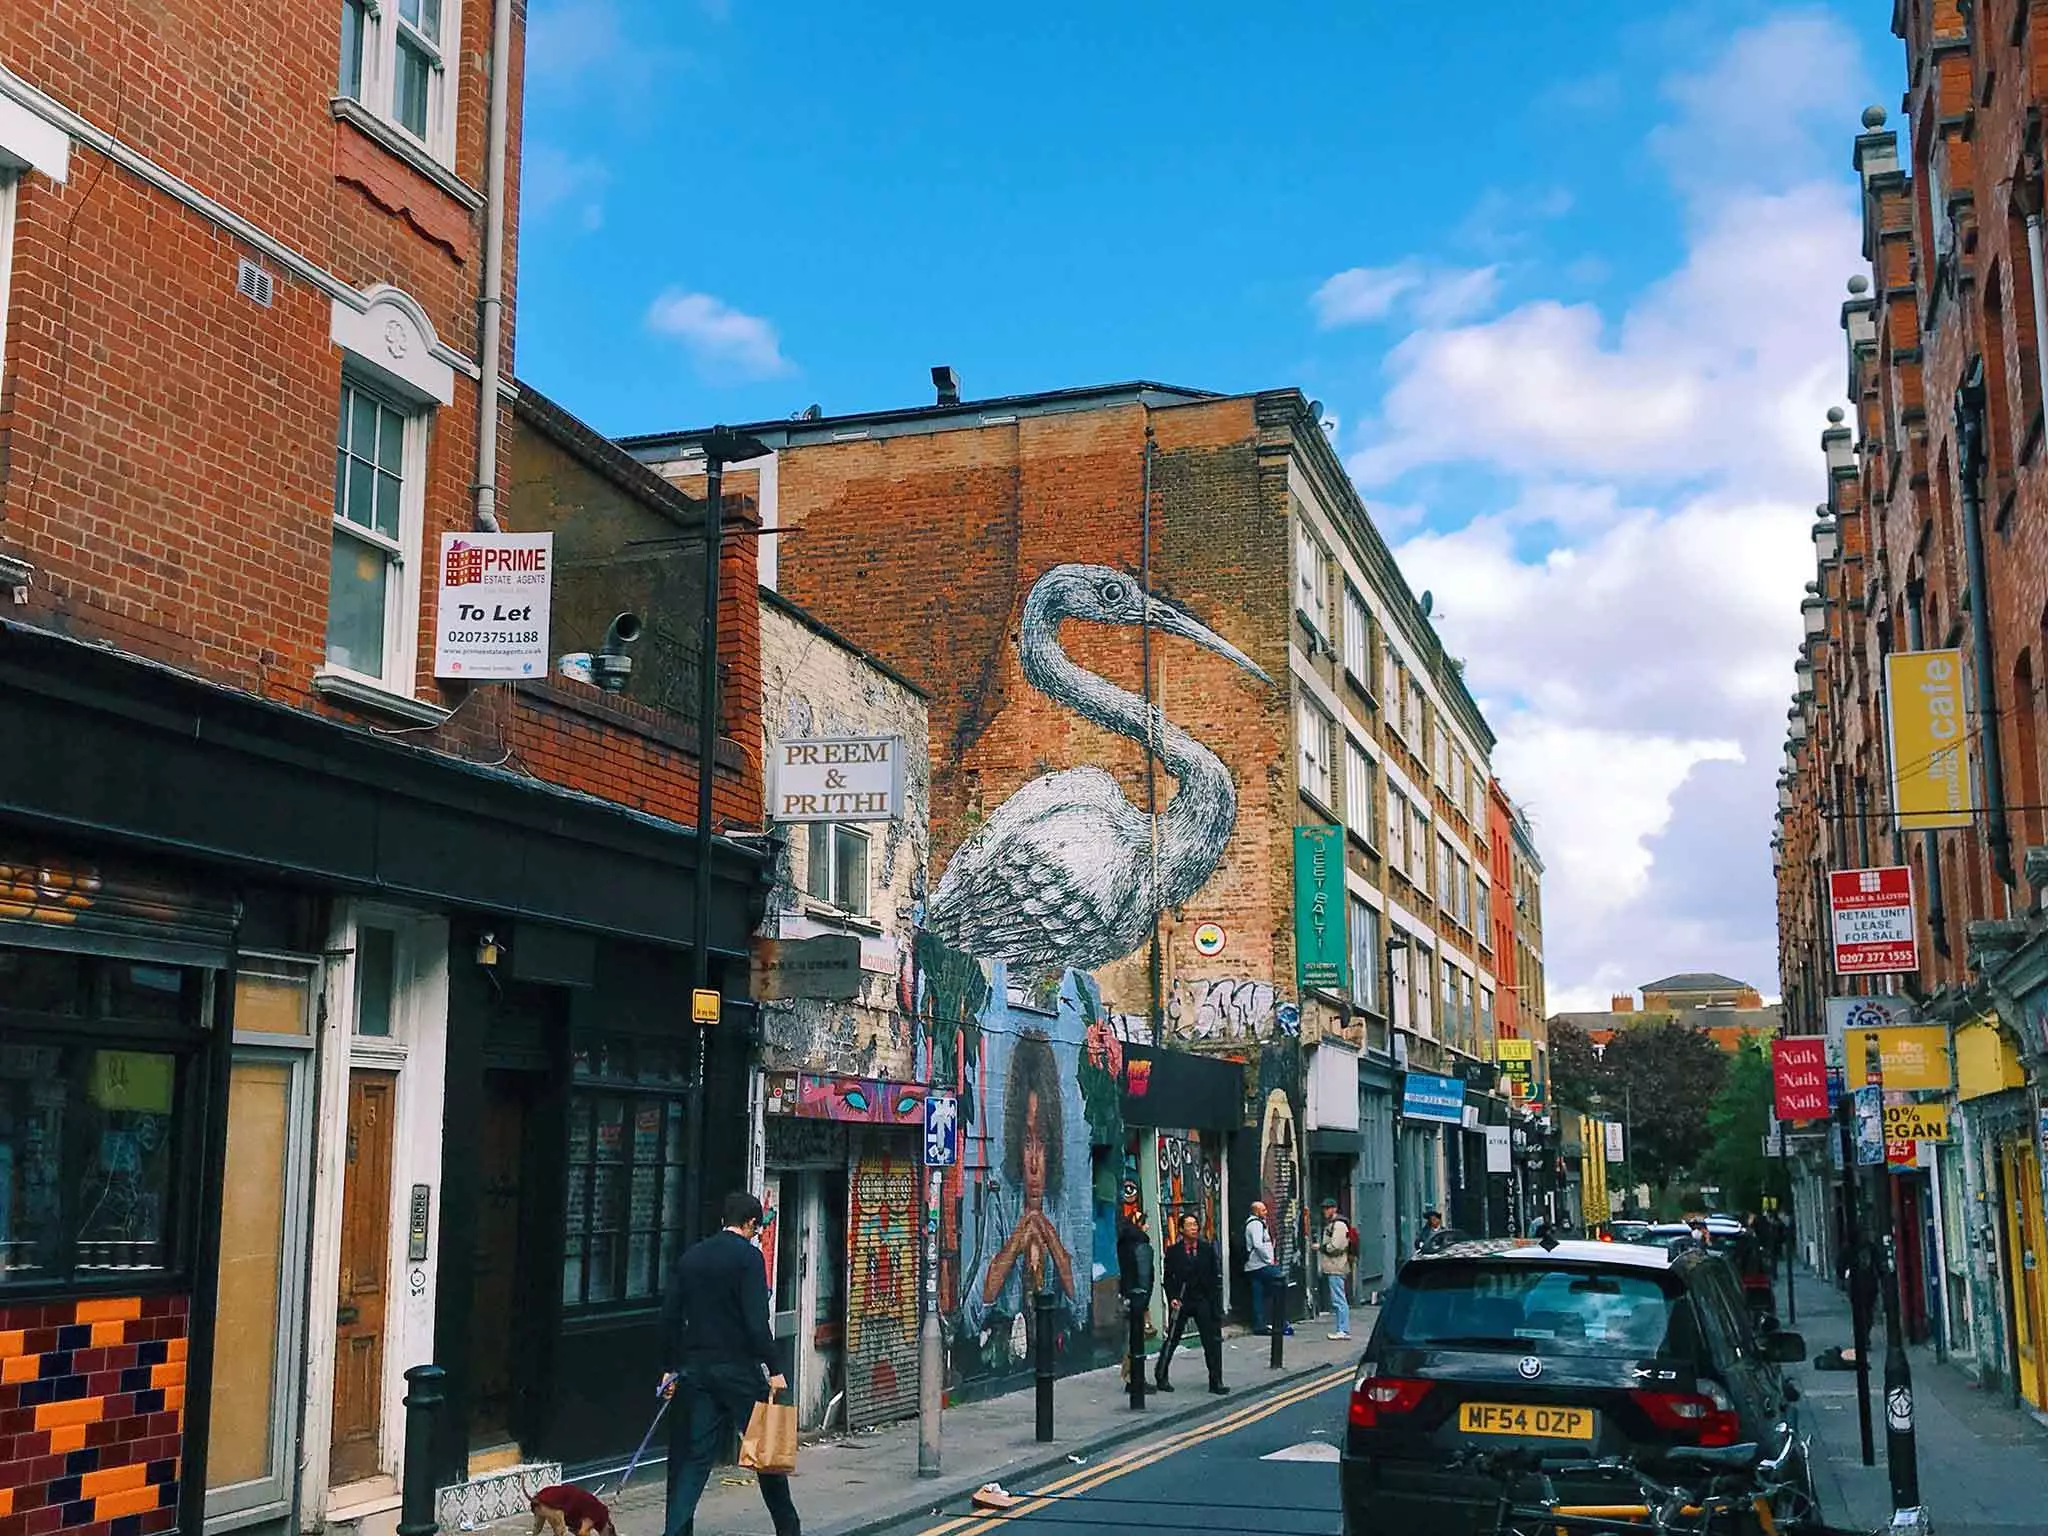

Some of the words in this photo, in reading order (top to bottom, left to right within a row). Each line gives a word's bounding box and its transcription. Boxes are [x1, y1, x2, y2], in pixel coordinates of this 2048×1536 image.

[484, 549, 546, 571] PRIME
[484, 575, 512, 585] ESTATE
[516, 574, 546, 584] AGENTS
[458, 605, 485, 621] To
[493, 604, 531, 621] Let
[448, 631, 539, 643] 02073751188
[1919, 658, 1957, 740] cafe
[784, 742, 889, 765] PREEM
[825, 768, 847, 789] &
[782, 792, 888, 814] PRITHI
[1839, 911, 1878, 921] RETAIL
[1881, 908, 1906, 919] UNIT
[1854, 920, 1893, 931] LEASE
[1845, 932, 1869, 942] FOR
[1873, 930, 1903, 940] SALE
[1839, 953, 1864, 964] 0207
[1888, 950, 1913, 961] 1555
[1778, 1050, 1818, 1065] Nails
[1780, 1072, 1820, 1088] Nails
[1782, 1093, 1822, 1110] Nails
[1884, 1122, 1942, 1138] EGAN
[1507, 1178, 1516, 1238] VINTAG
[1468, 1407, 1528, 1431] MF54
[1535, 1410, 1581, 1434] OZP
